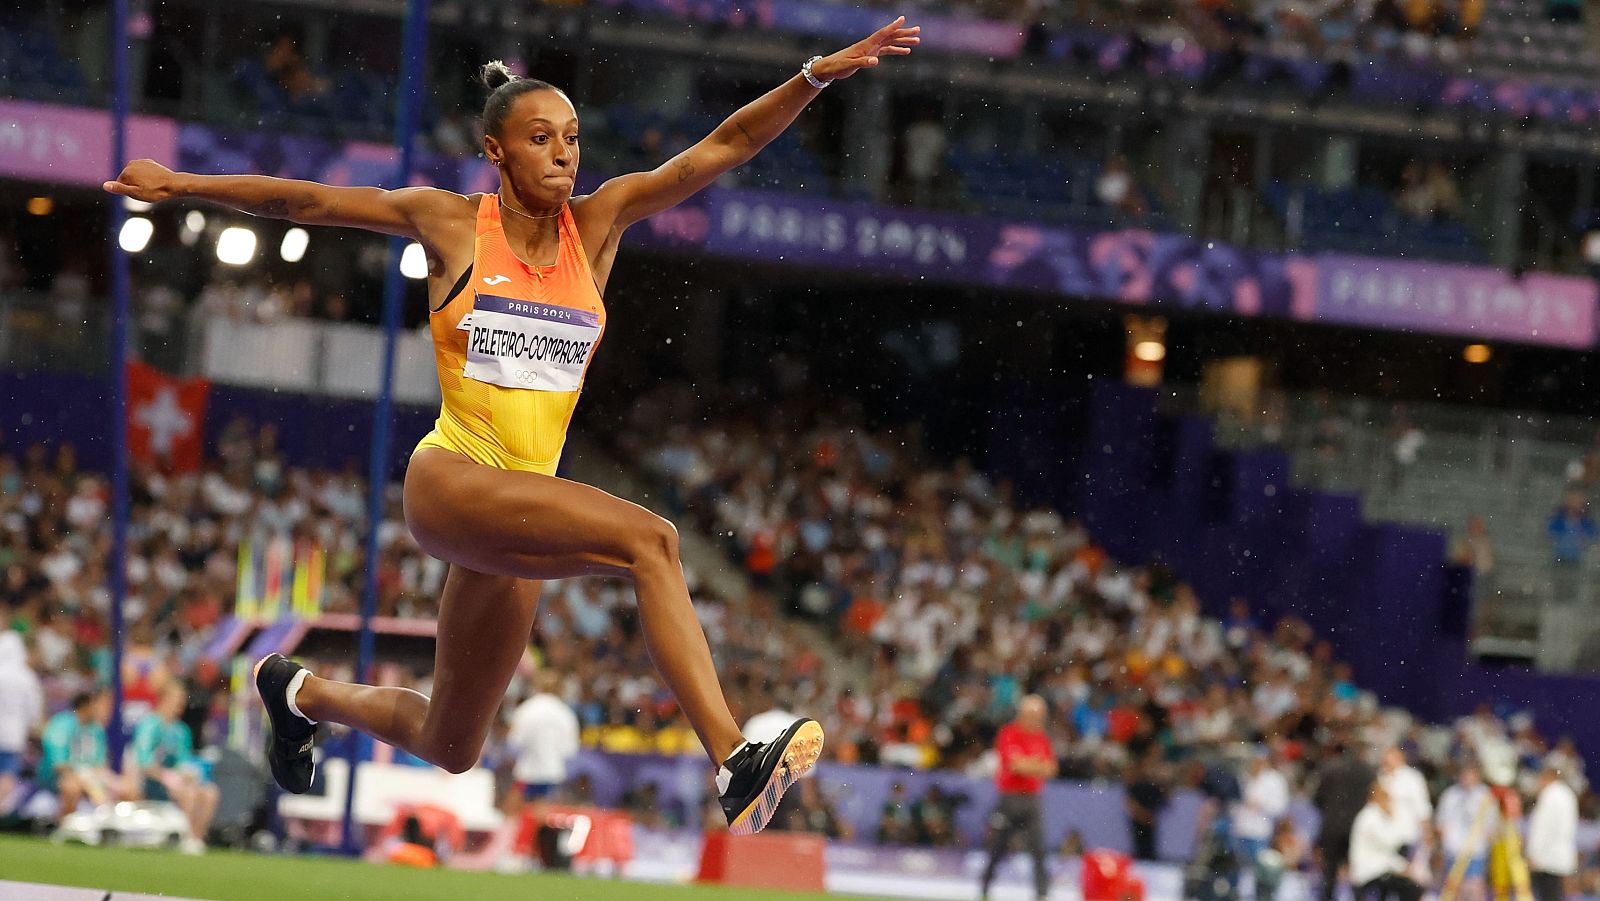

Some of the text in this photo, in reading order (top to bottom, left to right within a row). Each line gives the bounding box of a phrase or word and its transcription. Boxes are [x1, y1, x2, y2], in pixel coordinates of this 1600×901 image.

[722, 201, 967, 264] PARIS 2024
[508, 302, 571, 320] PARIS 2024
[472, 327, 591, 364] PELETEIRO-COMPAORE
